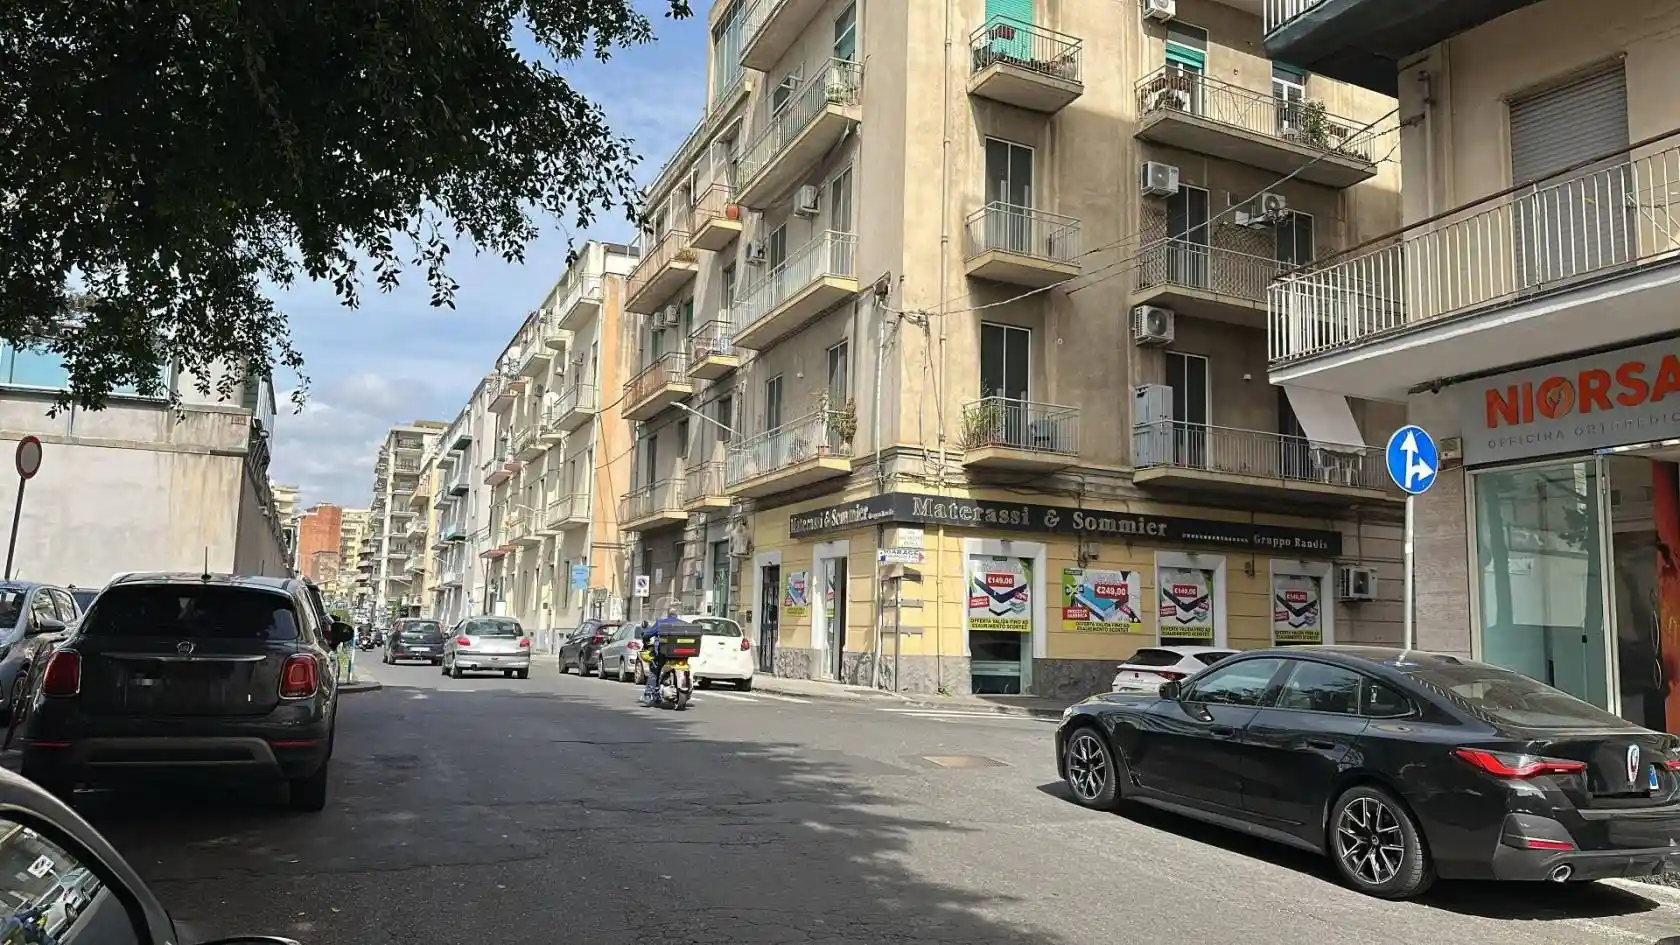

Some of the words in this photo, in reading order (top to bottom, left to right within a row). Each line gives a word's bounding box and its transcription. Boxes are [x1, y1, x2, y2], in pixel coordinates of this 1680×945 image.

[1488, 430, 1565, 449] OFFICINA
[831, 503, 868, 527] Sommier
[912, 496, 1030, 526] Materassi
[1044, 509, 1060, 528] &
[1073, 511, 1168, 537] Sommier
[1253, 533, 1291, 549] Gruppo
[1294, 537, 1328, 550] Randis
[1096, 586, 1126, 597] €249,00
